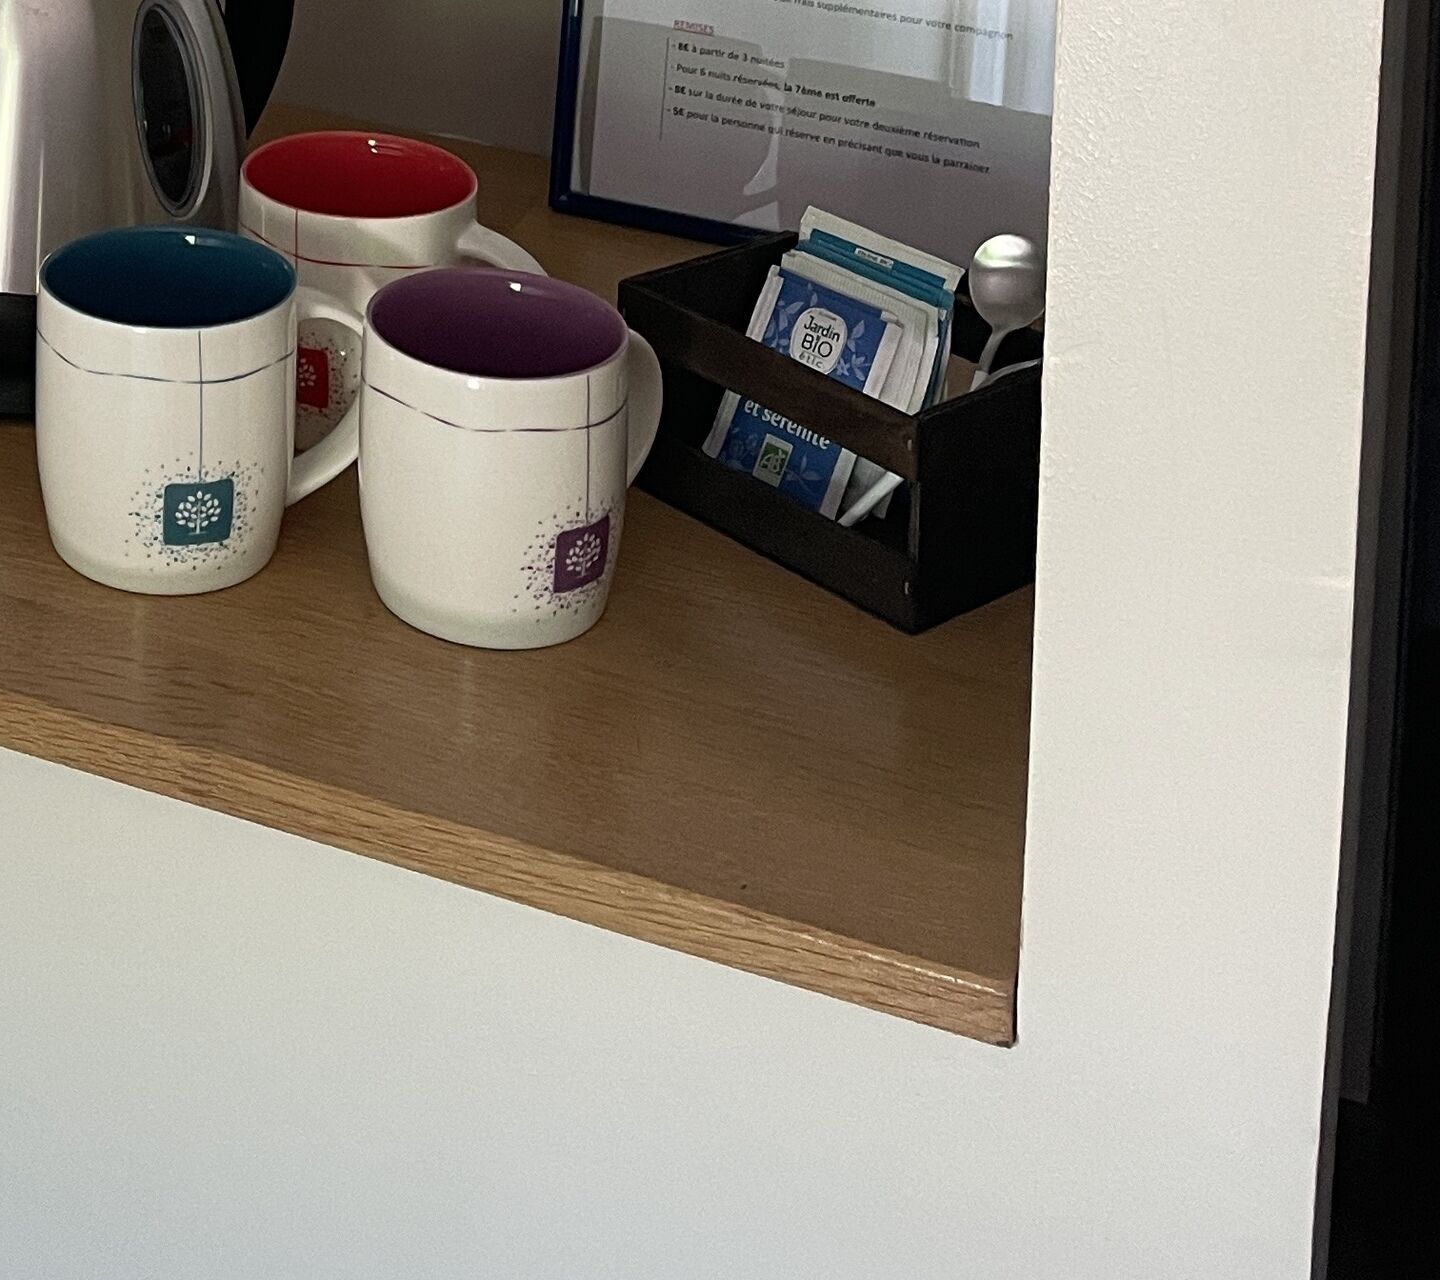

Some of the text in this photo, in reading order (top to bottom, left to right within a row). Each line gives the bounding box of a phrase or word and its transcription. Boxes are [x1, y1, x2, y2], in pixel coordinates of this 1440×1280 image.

[900, 15, 923, 25] pour
[926, 19, 951, 30] votre
[804, 315, 840, 342] Jardin
[745, 400, 760, 416] et
